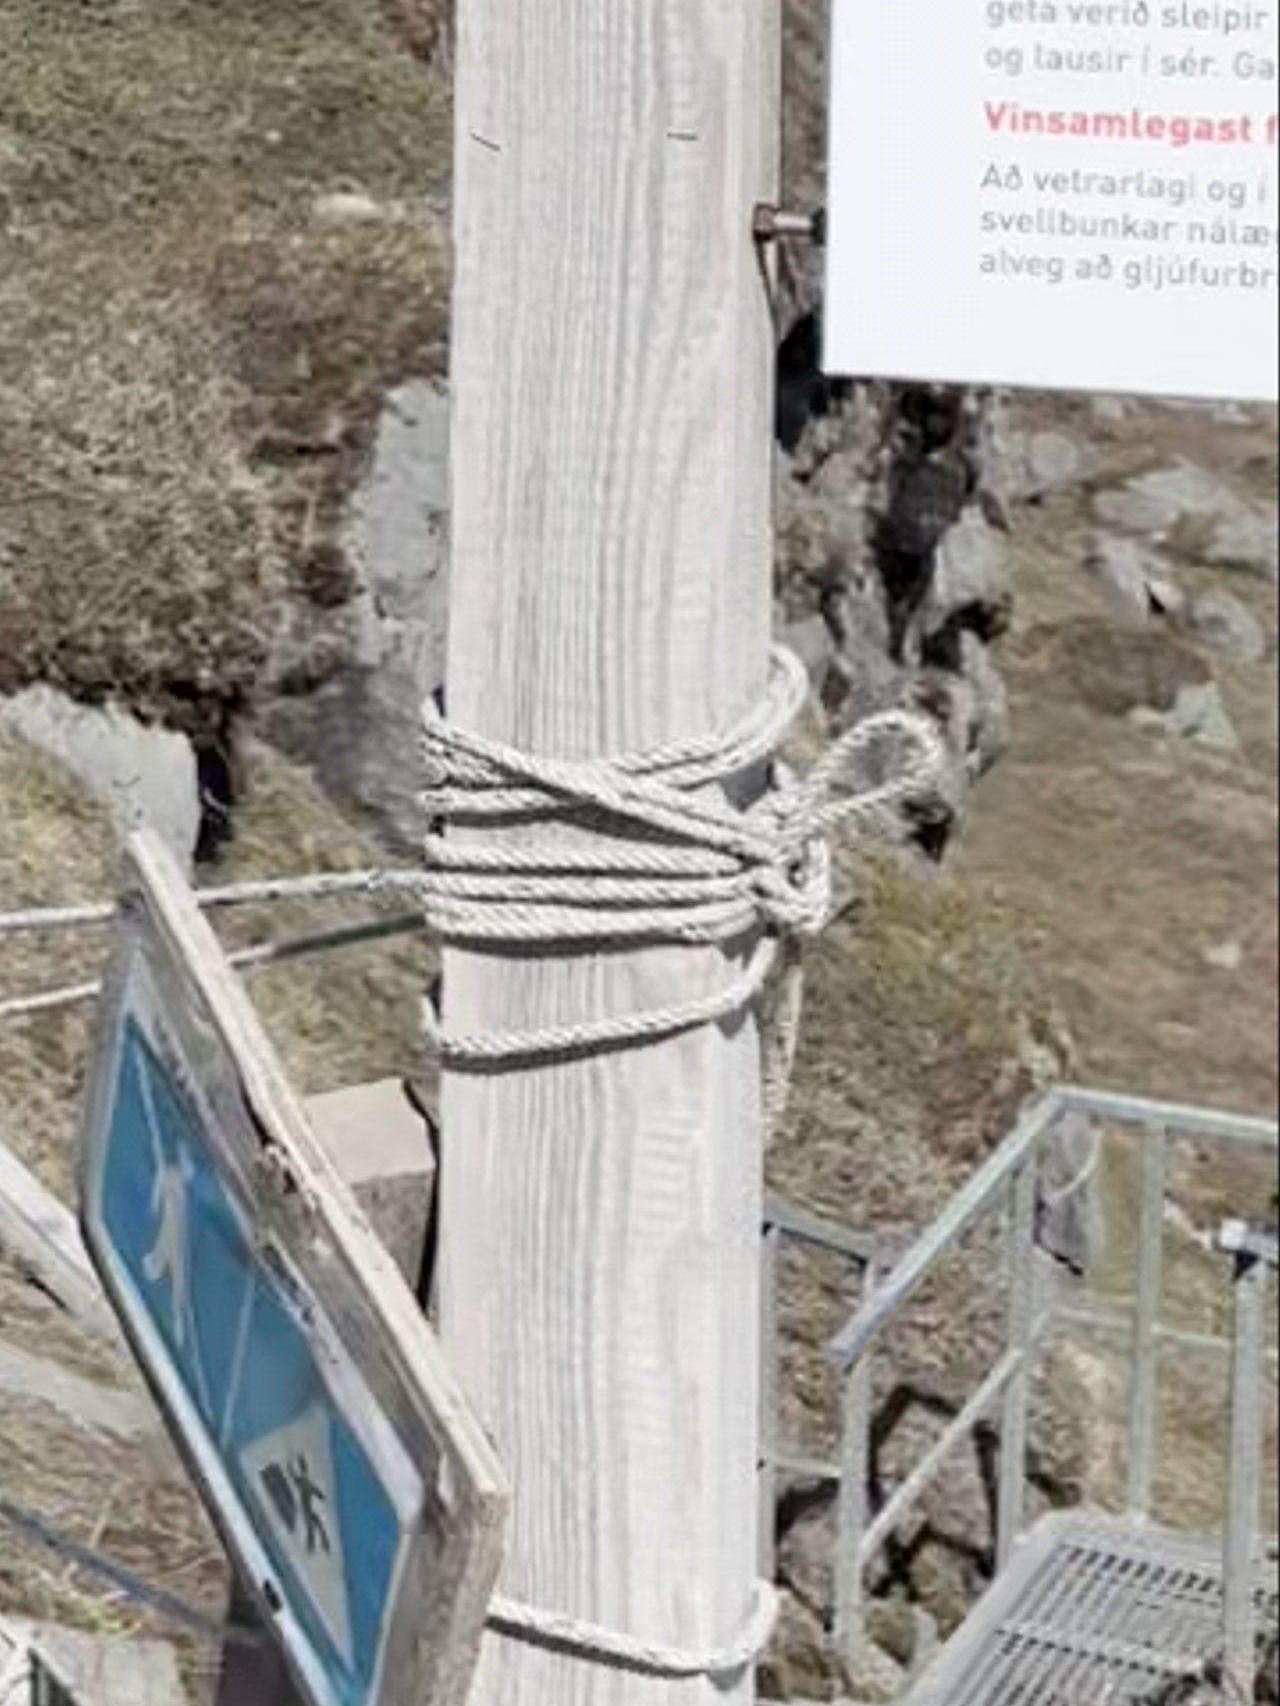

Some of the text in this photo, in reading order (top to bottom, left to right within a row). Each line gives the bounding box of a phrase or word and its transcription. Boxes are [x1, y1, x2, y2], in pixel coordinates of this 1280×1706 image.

[1067, 1, 1149, 28] verið
[1161, 2, 1269, 35] sleipir
[985, 46, 1023, 77] og
[1034, 44, 1132, 73] lausir
[984, 101, 1252, 147] Vinsamlegast
[980, 163, 1023, 191] Að
[1033, 169, 1197, 206] vetrarlagi
[1207, 180, 1246, 209] og
[980, 207, 1278, 246] svellbunkar nálæ
[979, 248, 1064, 284] alveg
[1075, 253, 1113, 281] að
